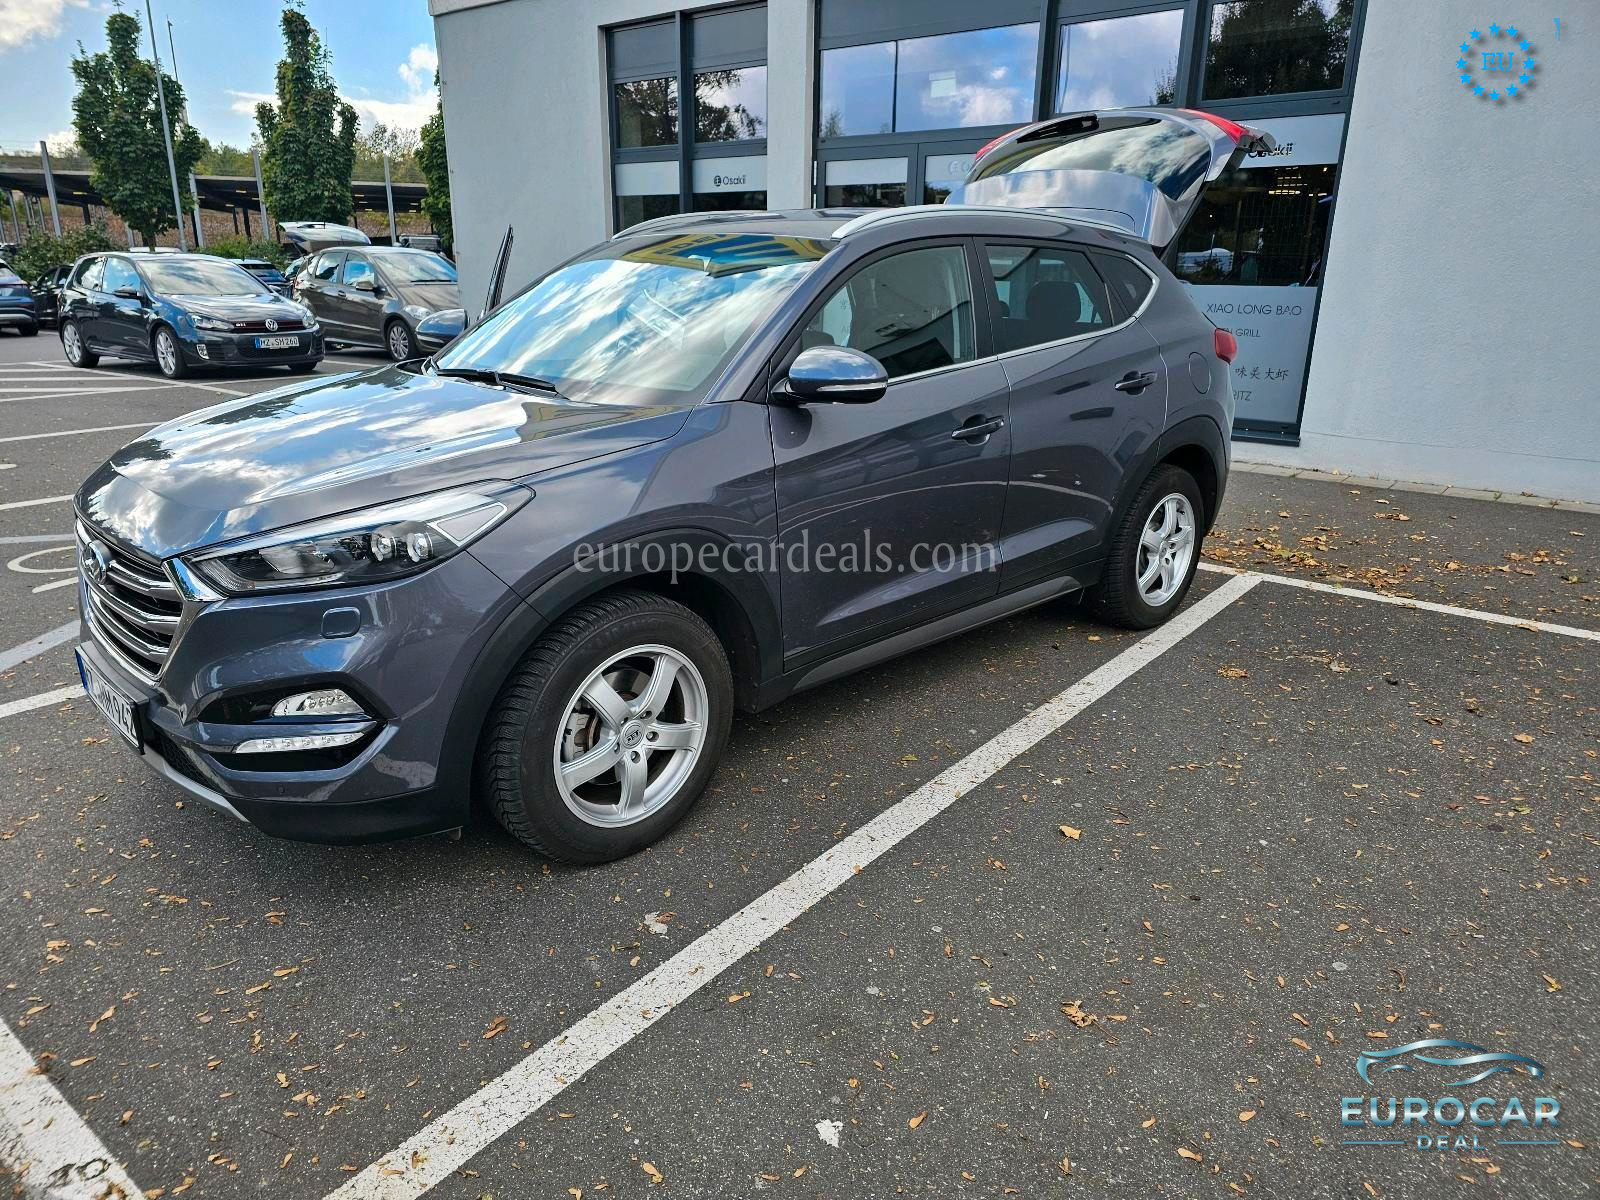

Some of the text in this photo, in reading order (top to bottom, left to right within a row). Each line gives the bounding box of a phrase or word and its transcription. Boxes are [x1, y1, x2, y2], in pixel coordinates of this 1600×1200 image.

[1206, 303, 1302, 316] XIAO LONG BAO
[1235, 328, 1261, 337] GRILL
